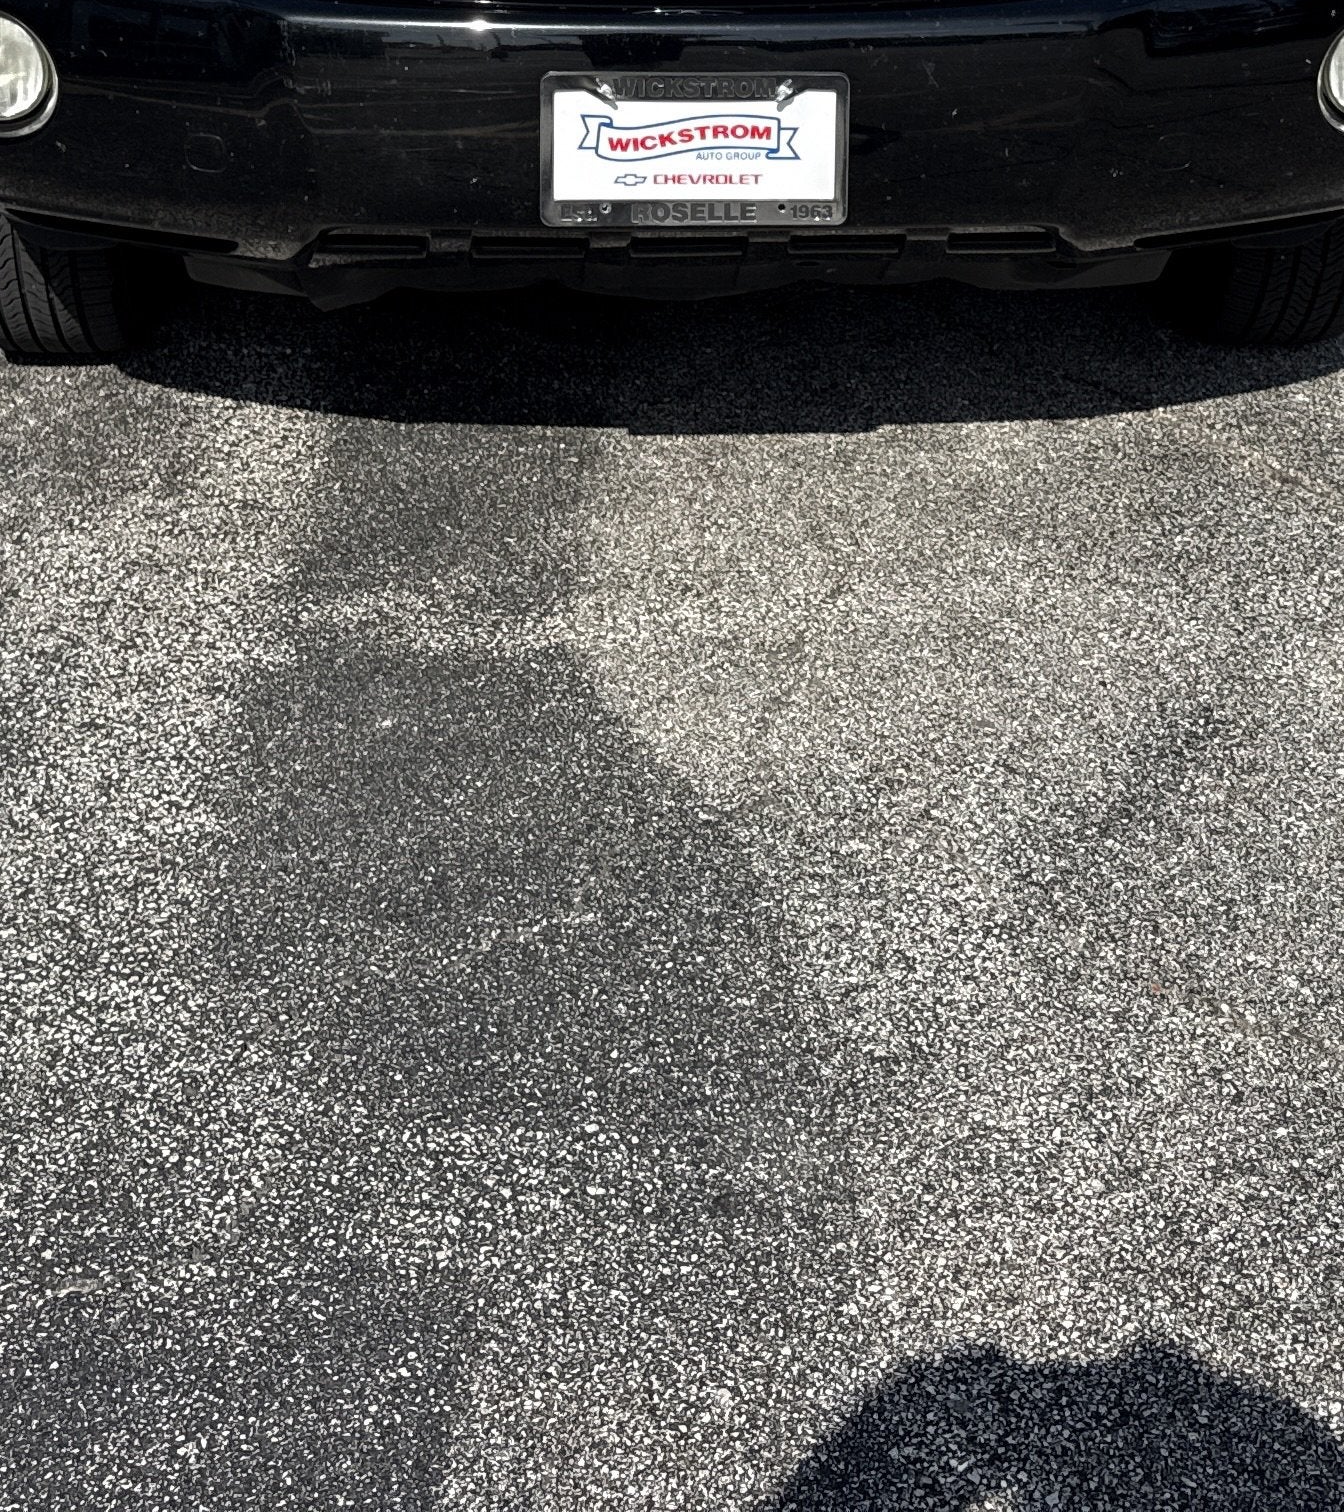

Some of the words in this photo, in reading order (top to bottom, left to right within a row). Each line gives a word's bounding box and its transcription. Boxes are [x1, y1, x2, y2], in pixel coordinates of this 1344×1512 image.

[612, 77, 778, 98] WICKSTROM
[608, 125, 772, 152] WICKSTROM
[696, 152, 724, 161] AUTO
[726, 152, 761, 161] GROUP
[653, 174, 763, 185] CHEVROLET
[631, 203, 758, 223] ROSELLE
[790, 204, 834, 221] 1963
